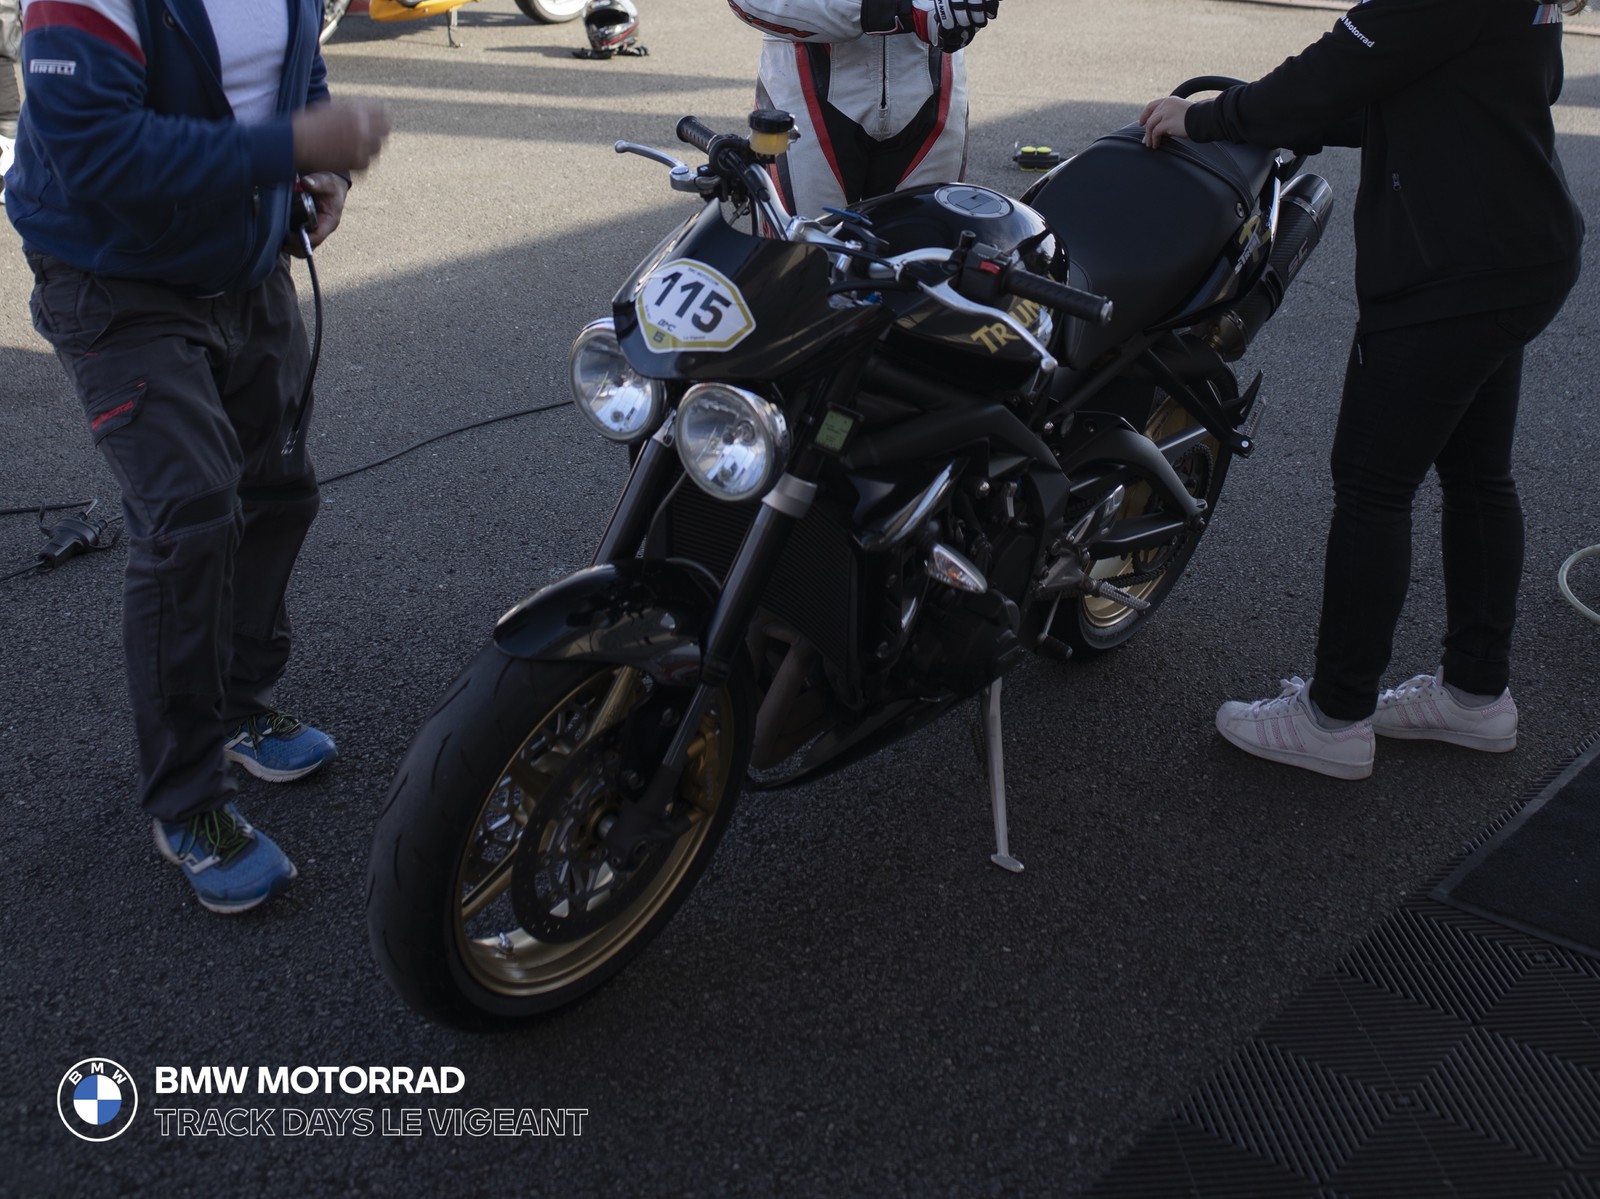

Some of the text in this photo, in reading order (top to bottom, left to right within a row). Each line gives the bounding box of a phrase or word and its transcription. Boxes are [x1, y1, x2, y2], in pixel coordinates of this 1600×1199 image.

[1343, 17, 1376, 48] Motorrad
[29, 58, 77, 76] PIRELLI
[654, 271, 732, 334] 115
